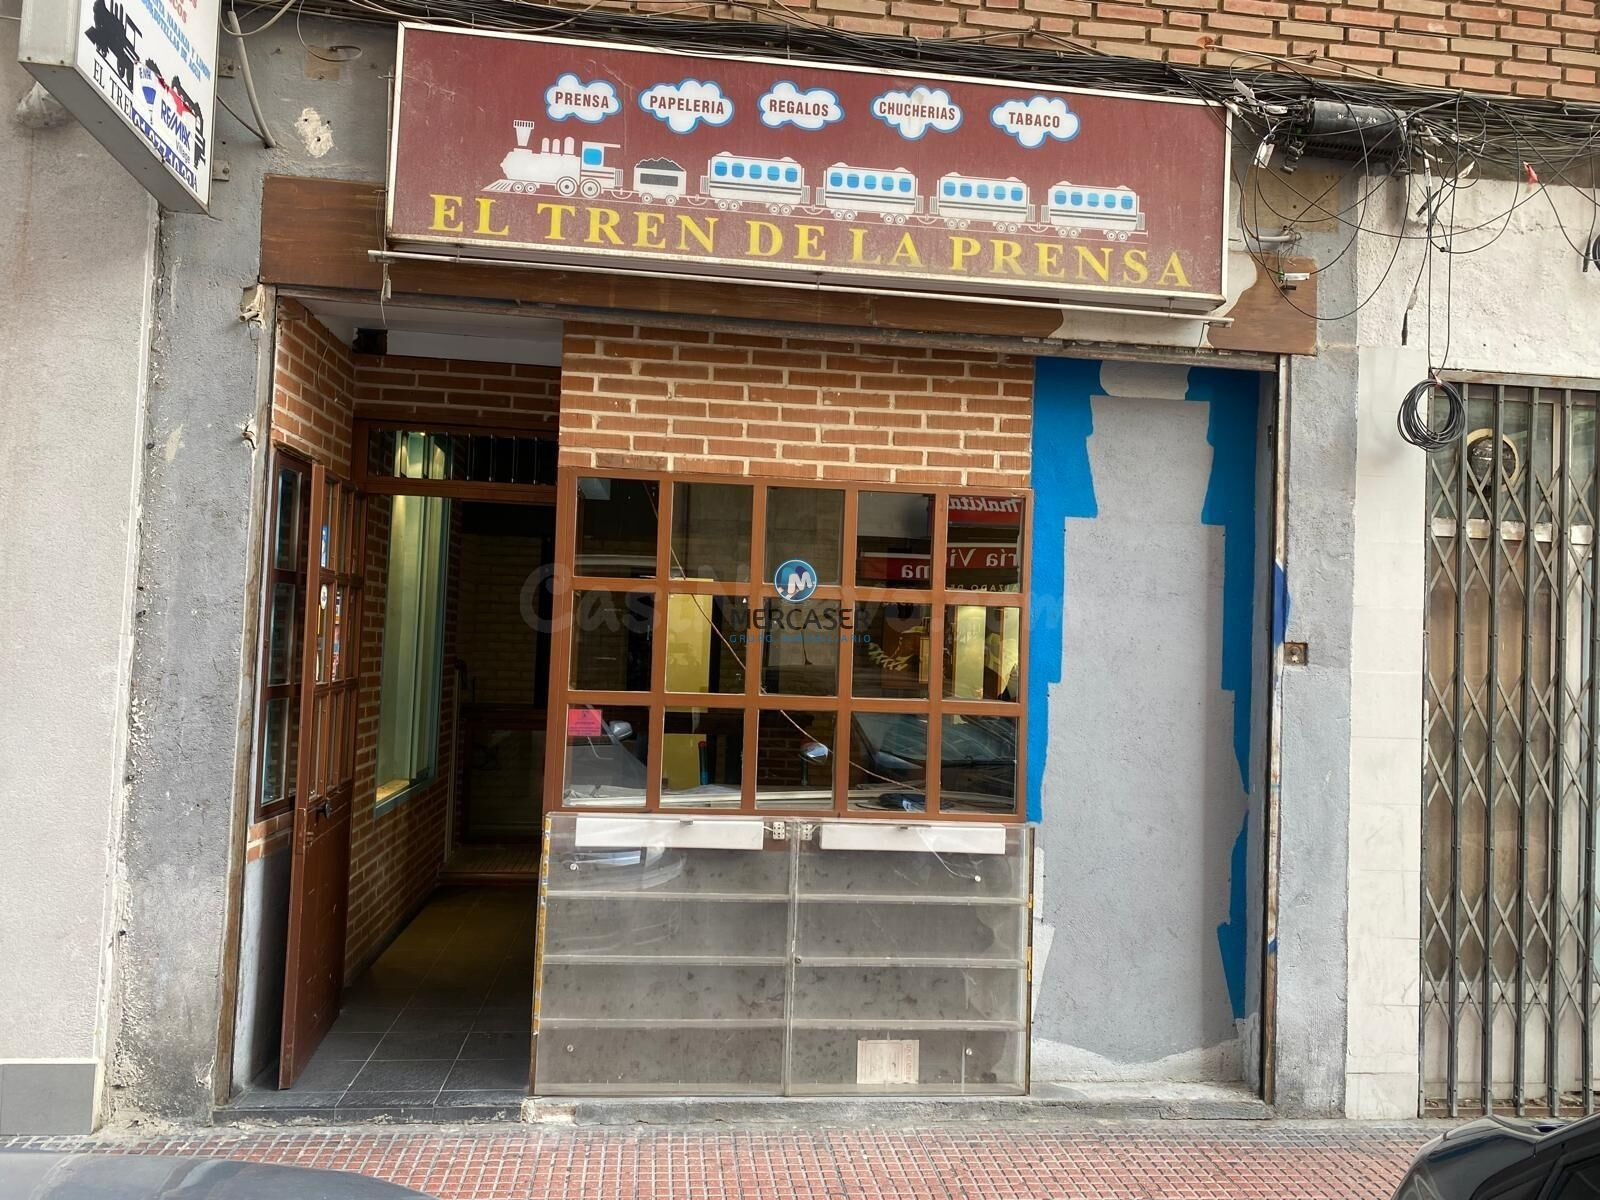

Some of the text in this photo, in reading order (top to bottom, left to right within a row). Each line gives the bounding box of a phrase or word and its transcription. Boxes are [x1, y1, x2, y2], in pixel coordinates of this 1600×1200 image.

[93, 59, 105, 90] EL
[554, 91, 610, 109] PRENSA
[650, 95, 725, 115] PAPELERIA
[769, 99, 829, 117] REGALOS
[878, 101, 956, 121] CHUCHERIAS
[1008, 111, 1061, 129] TABACO
[429, 194, 1192, 288] EL TREN DE LA PRENSA
